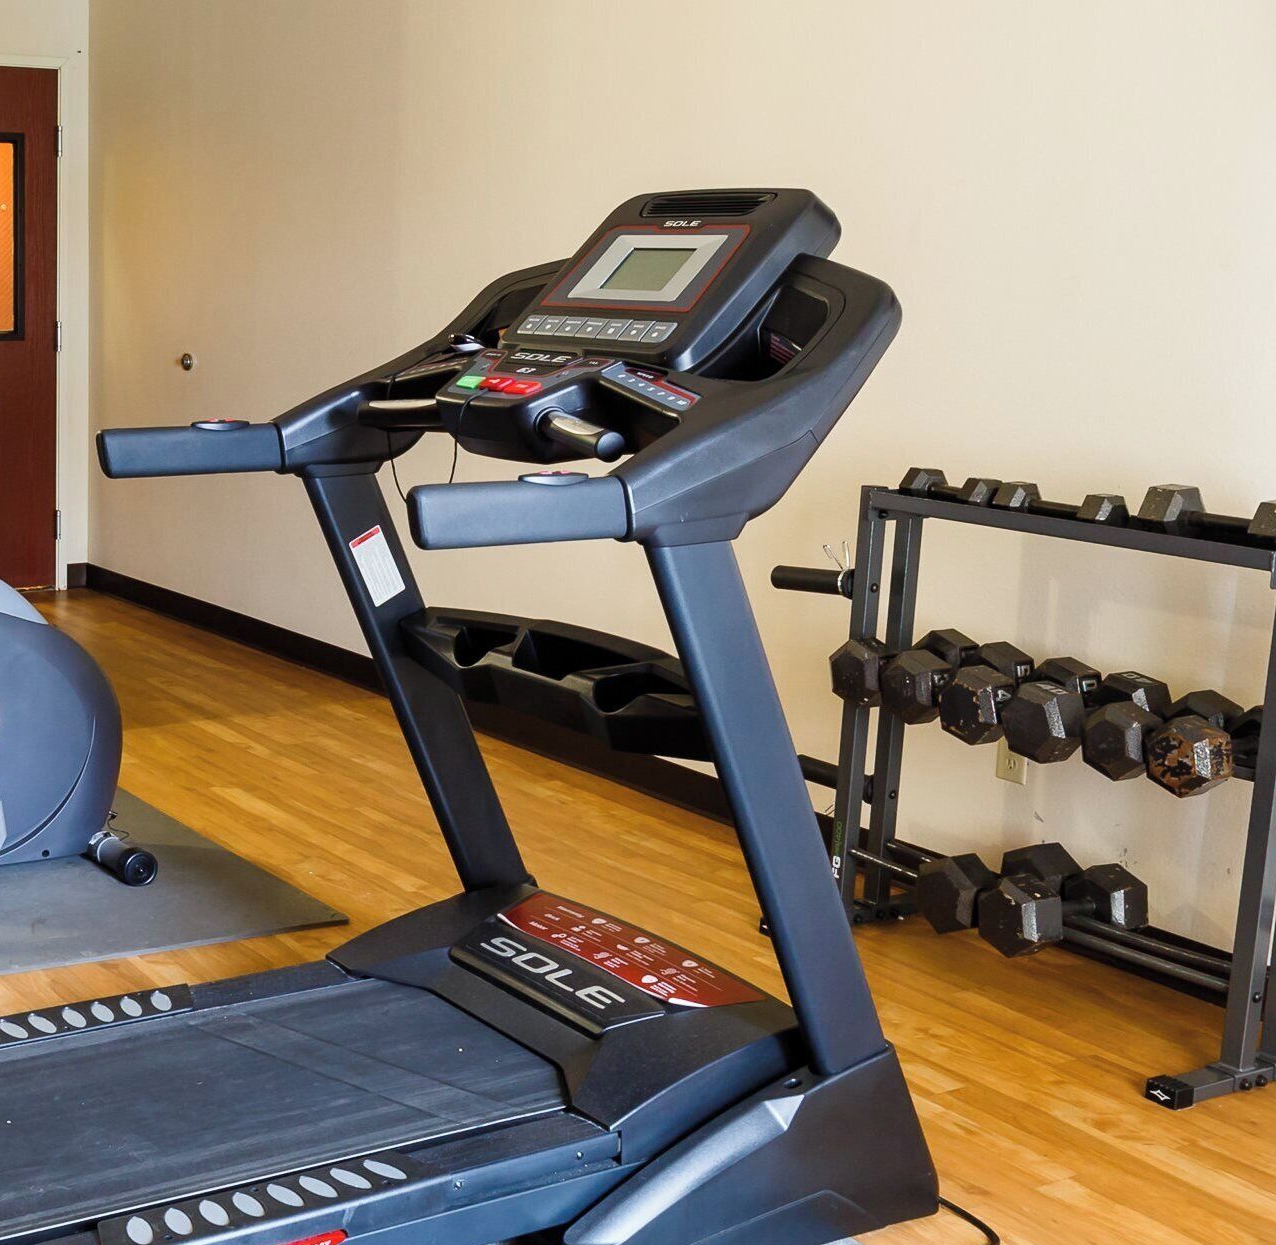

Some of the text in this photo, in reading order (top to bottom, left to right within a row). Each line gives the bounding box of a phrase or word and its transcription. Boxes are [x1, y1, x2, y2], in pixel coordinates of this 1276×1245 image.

[663, 220, 702, 228] SOLE
[510, 351, 572, 364] SOLE
[480, 936, 626, 1010] SOLE
